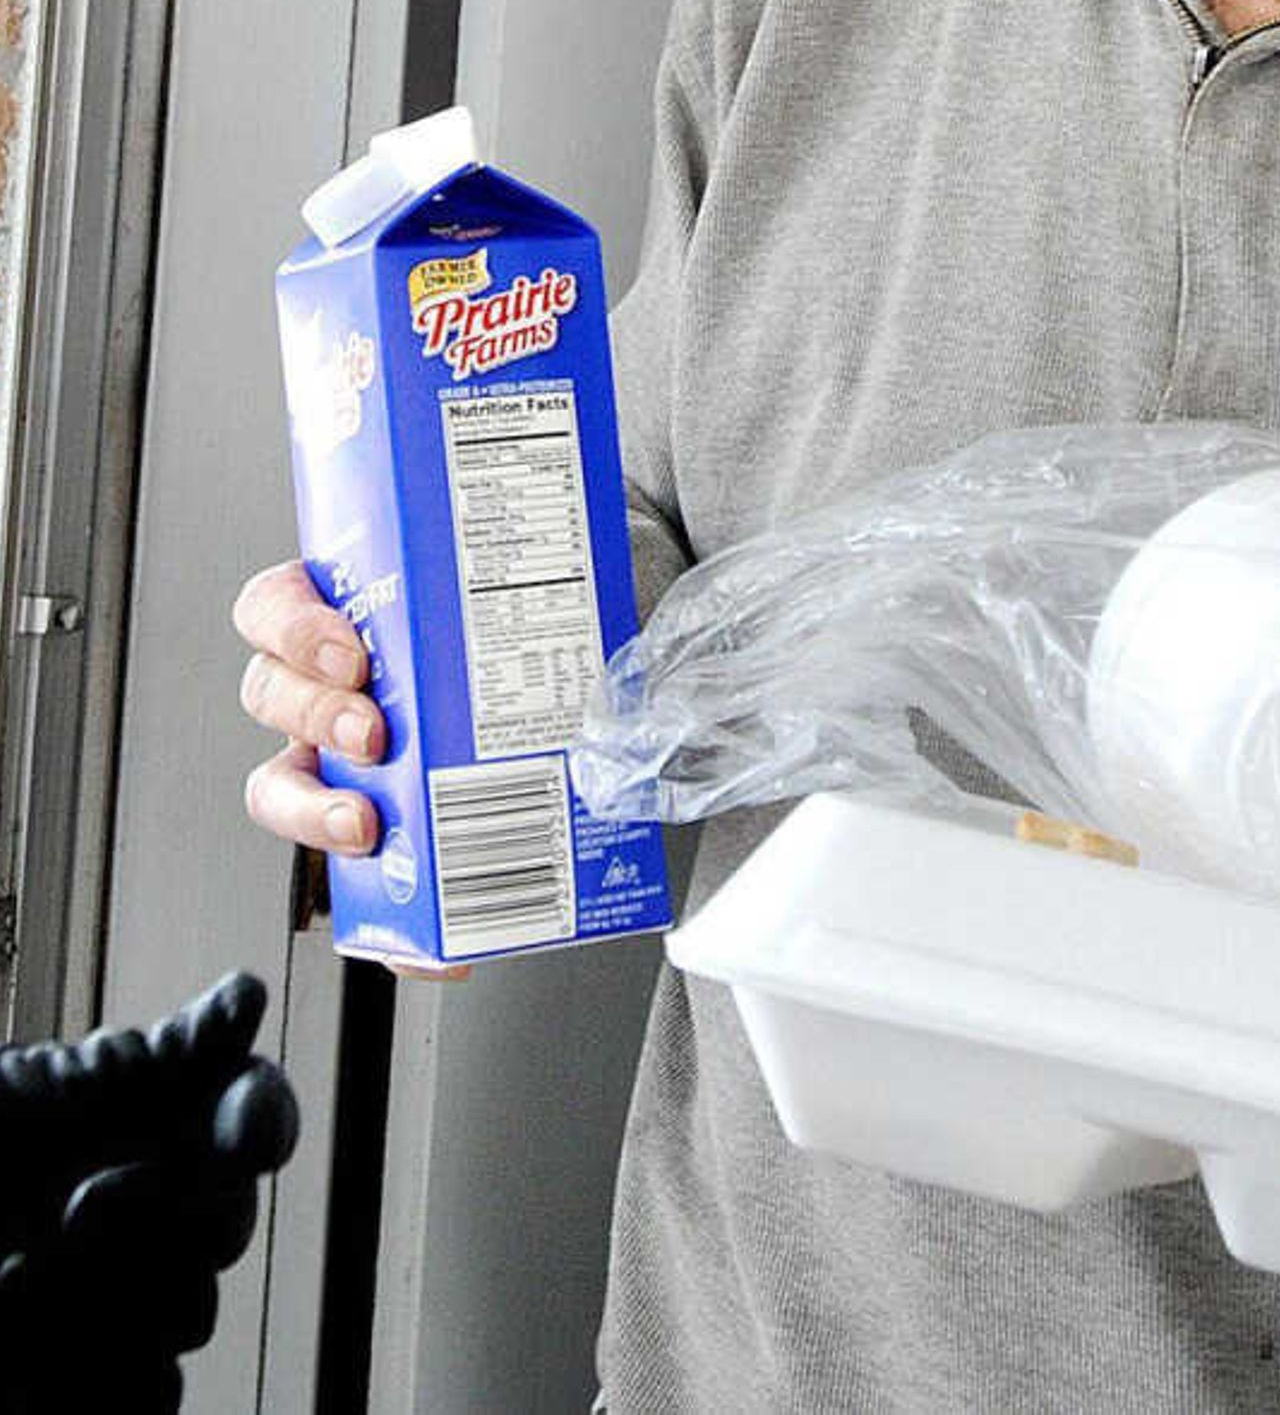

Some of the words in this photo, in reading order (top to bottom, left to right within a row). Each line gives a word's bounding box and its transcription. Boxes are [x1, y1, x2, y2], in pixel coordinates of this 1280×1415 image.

[417, 271, 573, 349] Prairie
[448, 319, 554, 372] Farms
[448, 400, 522, 417] Nutrition
[527, 396, 569, 412] Facts
